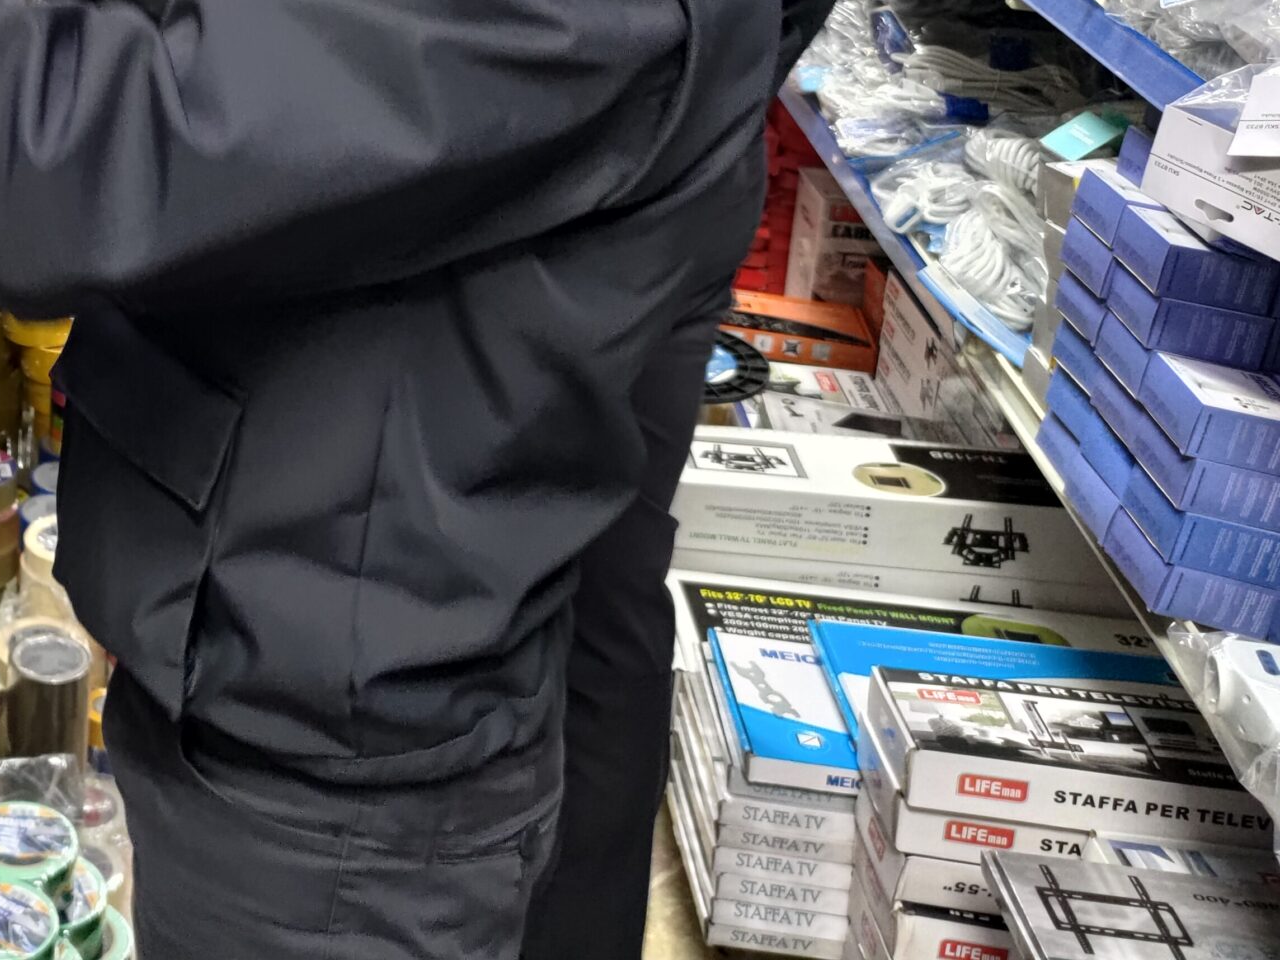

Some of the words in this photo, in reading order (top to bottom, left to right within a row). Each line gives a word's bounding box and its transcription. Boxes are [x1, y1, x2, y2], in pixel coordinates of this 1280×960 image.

[1241, 200, 1280, 226] -TAC
[918, 672, 1014, 690] STAFFA
[1018, 682, 1069, 697] PER
[742, 806, 800, 829] STAFFA
[803, 814, 826, 830] TV
[1054, 789, 1139, 814] STAFFA
[1146, 802, 1190, 821] PER
[1197, 808, 1273, 832] TELEV
[742, 832, 800, 853] STAFFA
[802, 841, 824, 855] TV
[1040, 838, 1083, 857] STA
[735, 853, 795, 876] STAFFA
[797, 861, 818, 877] TV
[739, 880, 797, 902] STAFFA
[799, 888, 821, 904] TV
[734, 903, 793, 925] STAFFA
[794, 912, 816, 927] TV
[730, 929, 788, 950] STAFFA
[790, 938, 813, 952] TV
